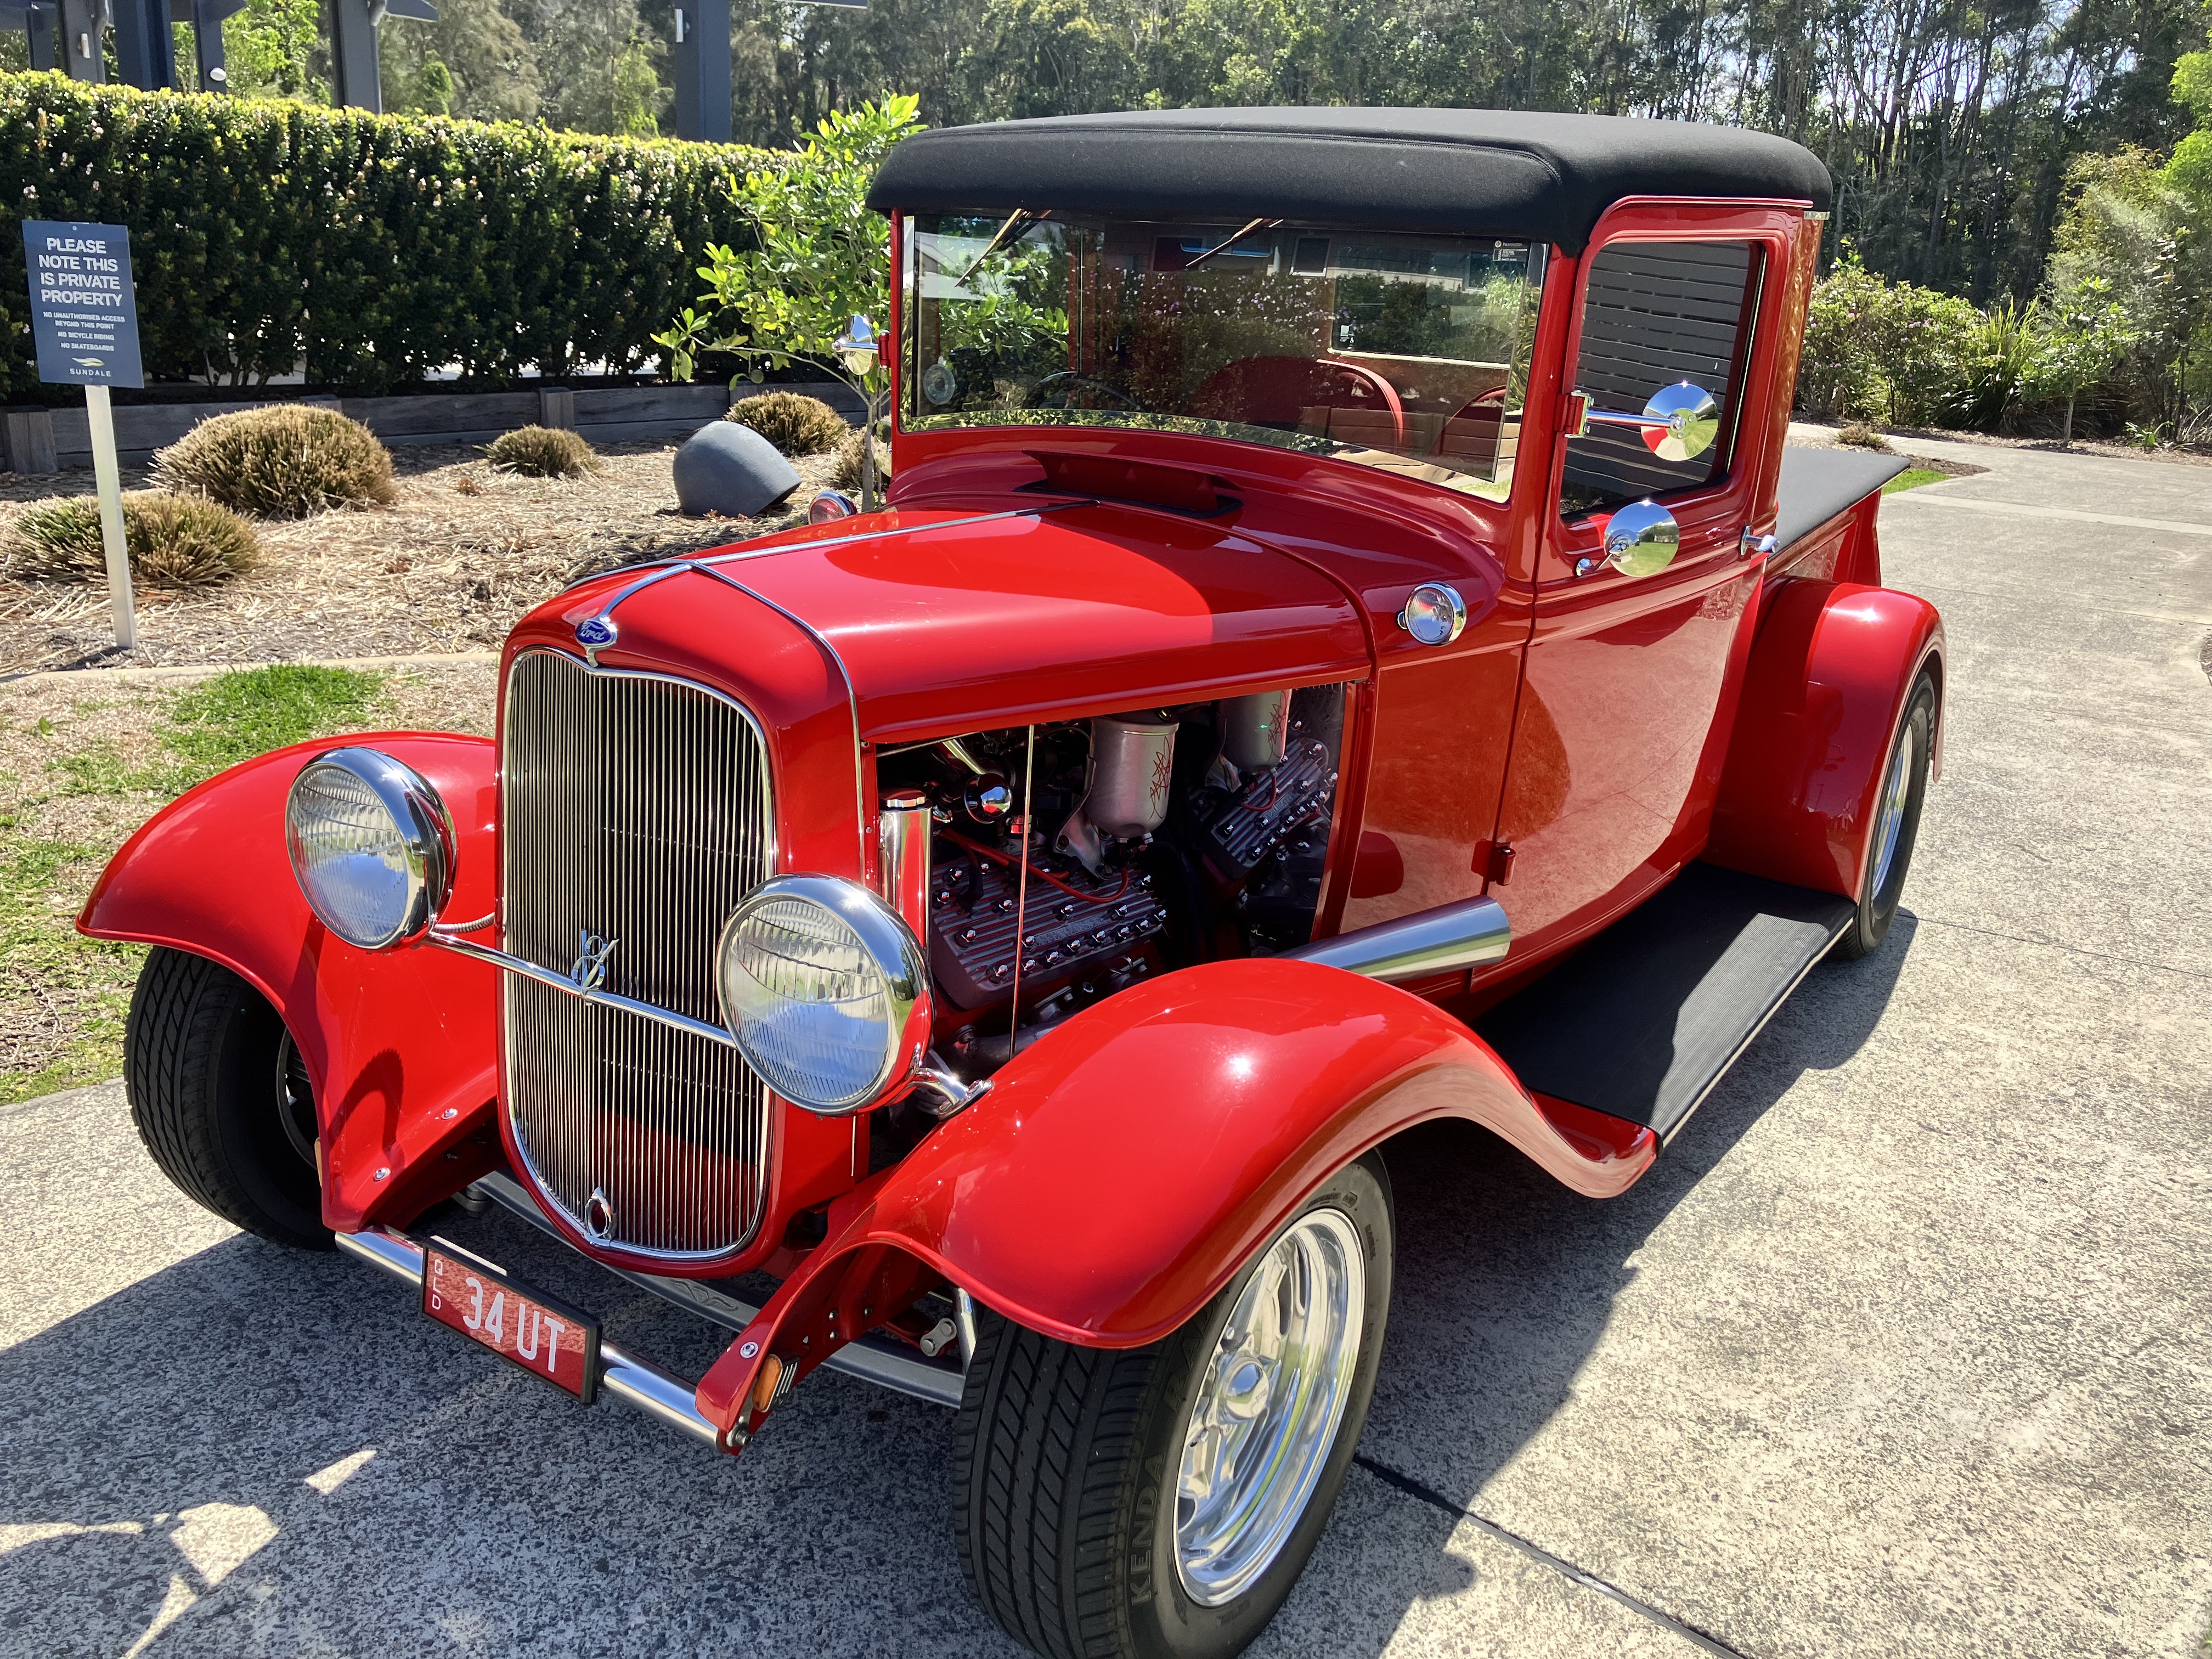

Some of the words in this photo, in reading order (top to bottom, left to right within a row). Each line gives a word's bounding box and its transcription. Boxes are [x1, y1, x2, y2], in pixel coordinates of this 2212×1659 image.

[47, 238, 106, 253] PLEASE
[38, 255, 81, 269] NOTE
[83, 257, 118, 272] THIS
[40, 272, 55, 285] IS
[58, 273, 120, 289] PRIVATE
[41, 289, 122, 307] PROPERTY
[53, 312, 100, 320] UNAUTHORISED
[71, 343, 114, 351] SKATEBOARDS
[70, 368, 111, 377] SUNDALE
[579, 622, 606, 640] Ford
[432, 1259, 443, 1310] QLD
[462, 1277, 504, 1344] 34
[516, 1302, 565, 1373] UT
[1130, 1452, 1167, 1606] KENDA
